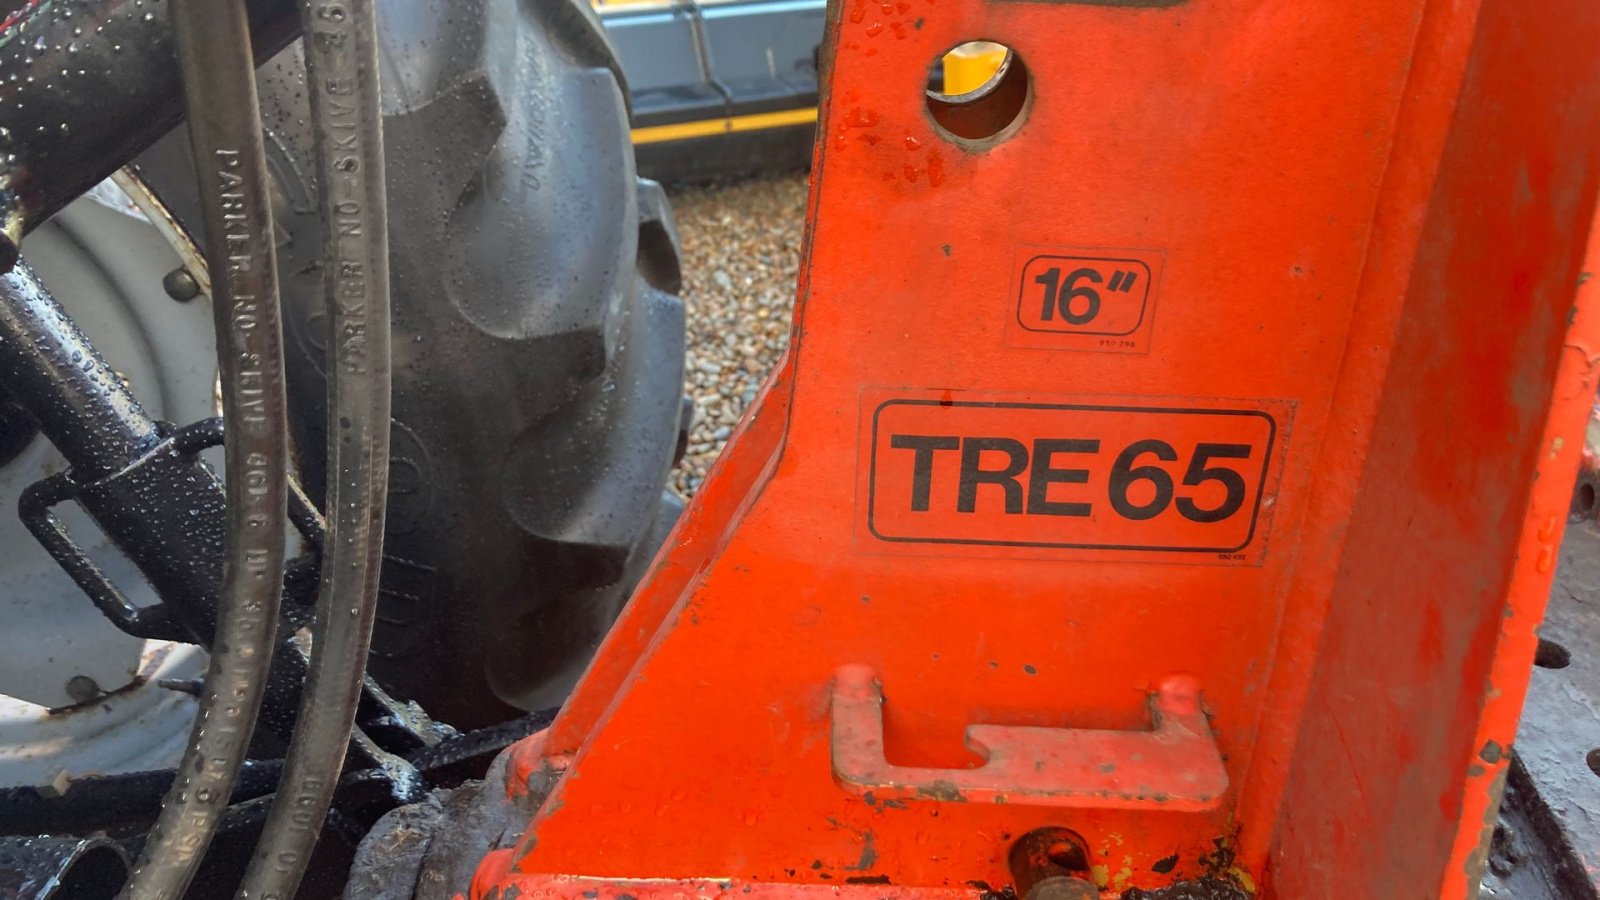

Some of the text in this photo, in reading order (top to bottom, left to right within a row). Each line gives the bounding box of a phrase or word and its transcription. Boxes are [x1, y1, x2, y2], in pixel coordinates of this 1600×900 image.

[214, 149, 250, 278] PARKER
[325, 76, 364, 237] NO-SKIVE
[338, 259, 369, 375] PARKER
[1034, 267, 1138, 325] 16"
[890, 434, 1252, 523] TRE 65
